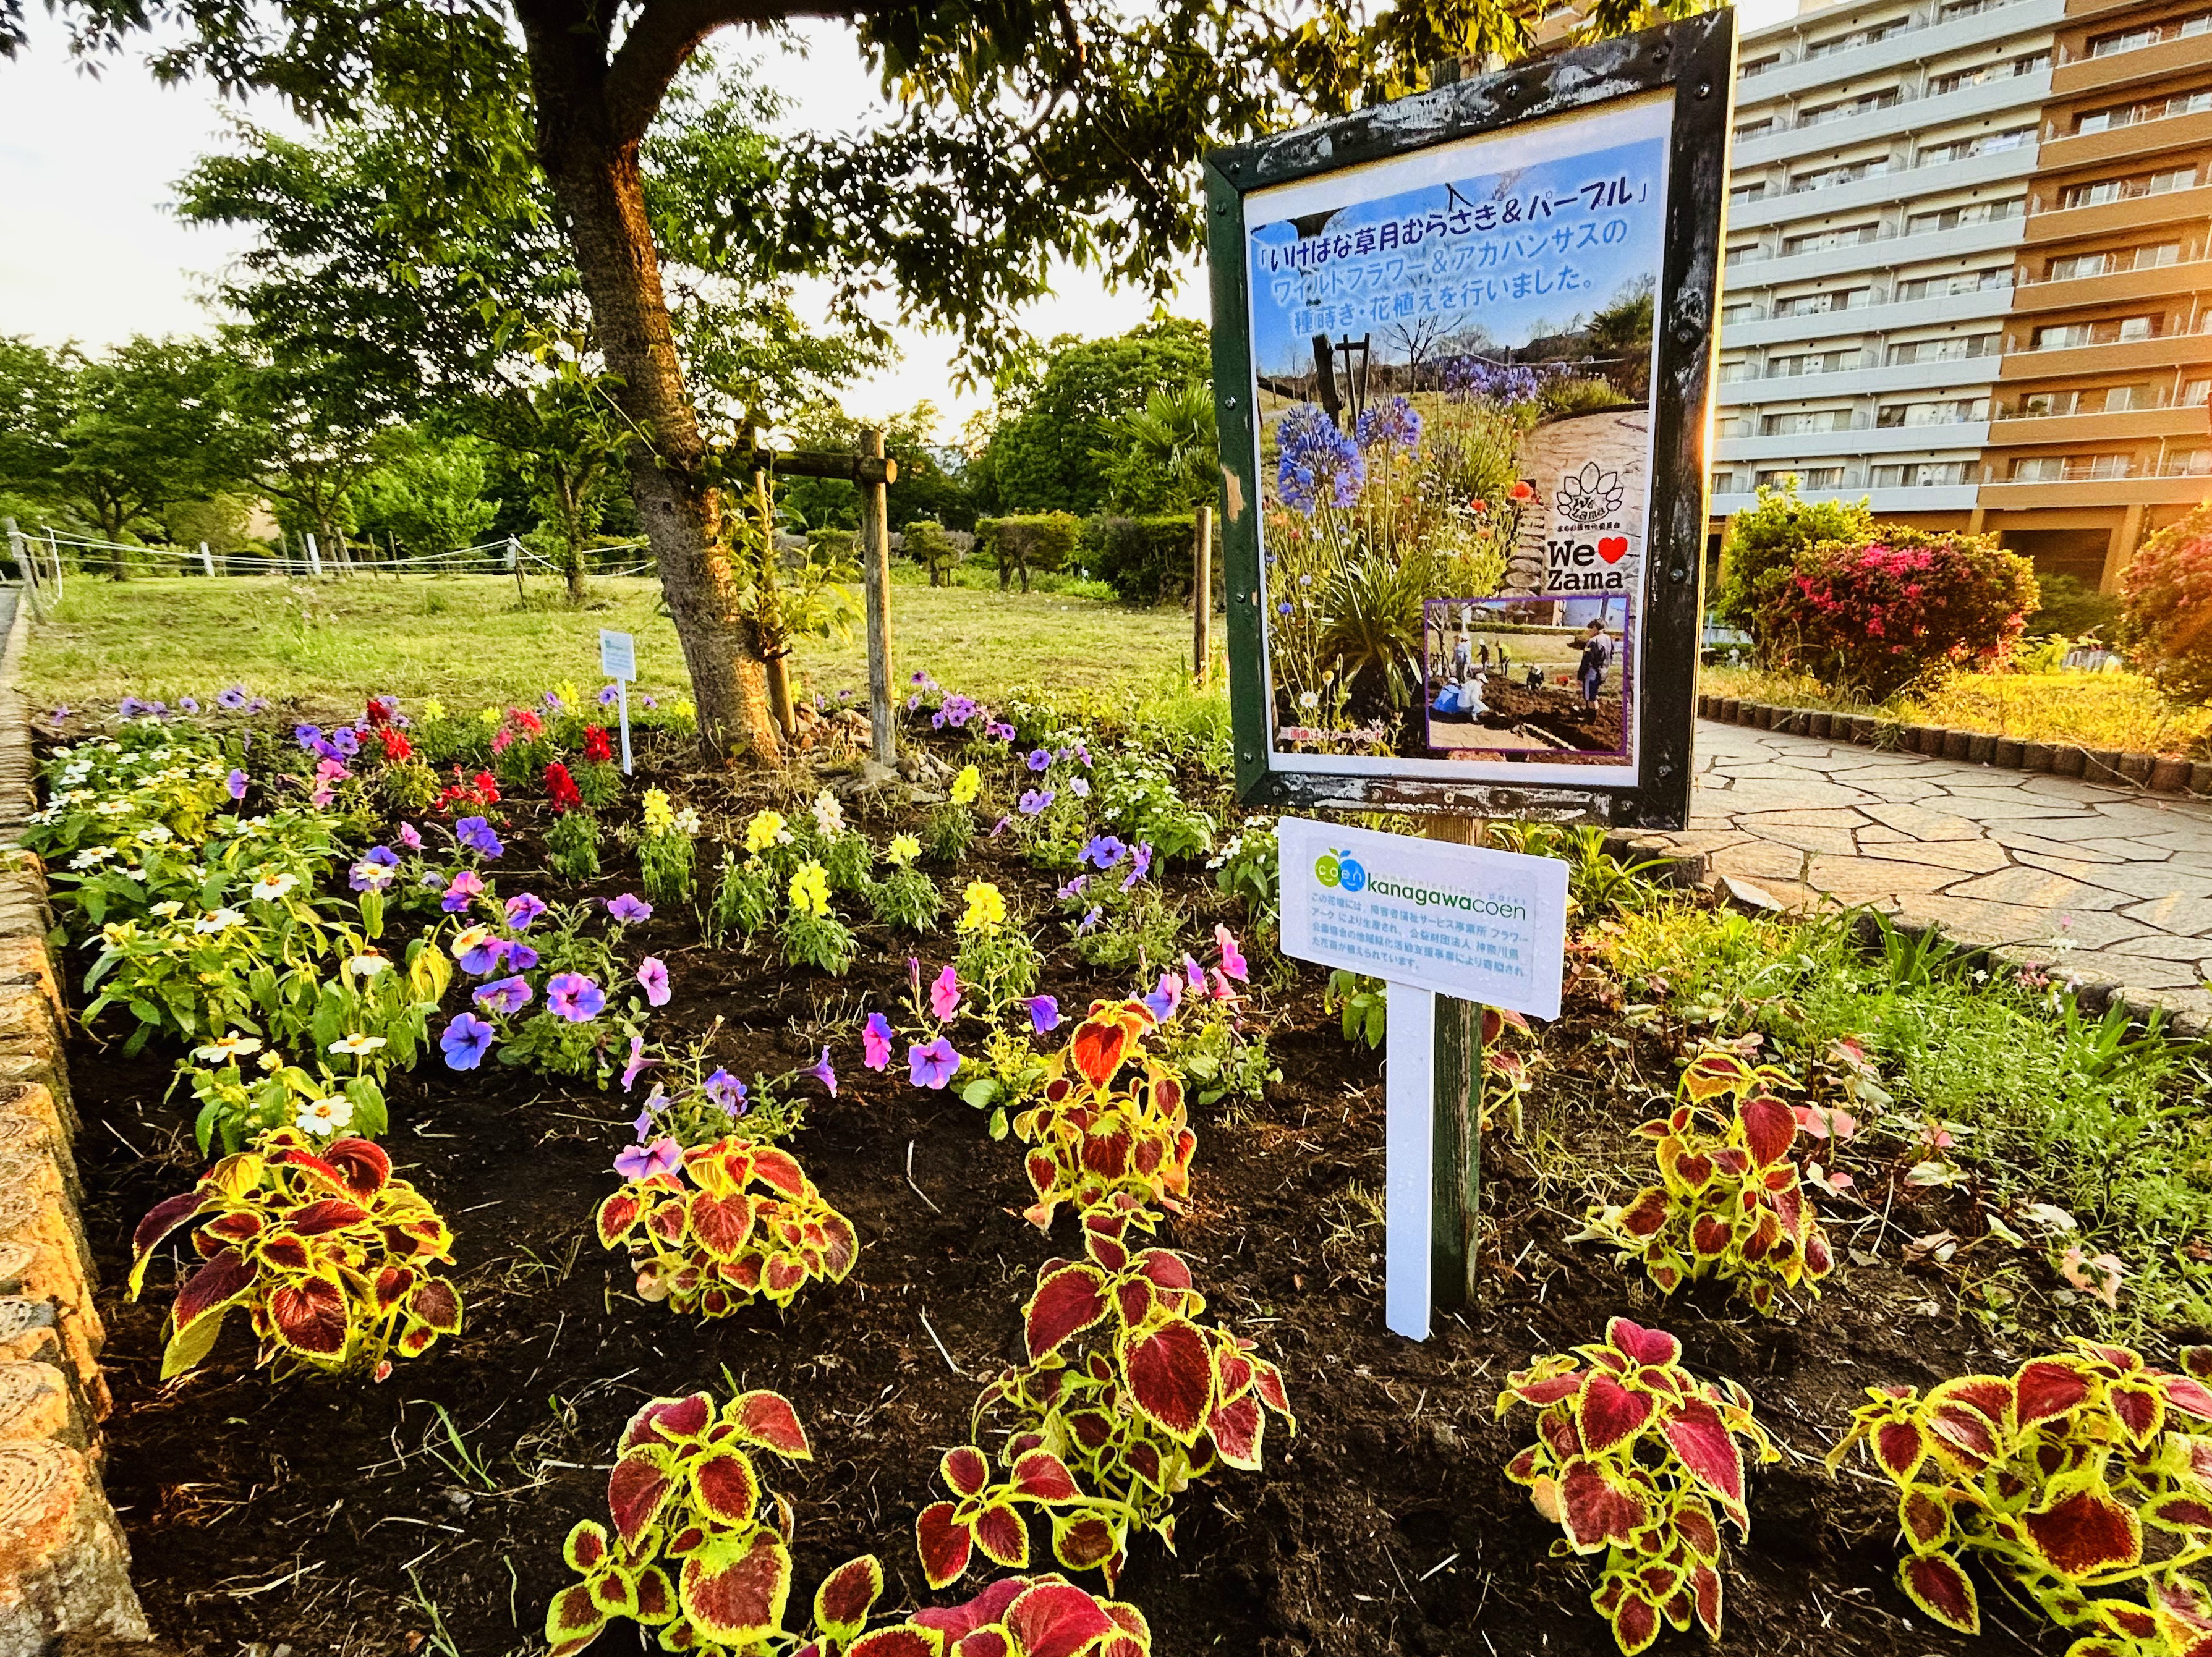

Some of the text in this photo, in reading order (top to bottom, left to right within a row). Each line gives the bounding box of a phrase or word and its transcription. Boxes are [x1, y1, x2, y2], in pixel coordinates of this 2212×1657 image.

[1547, 540, 1595, 567] We
[1547, 570, 1623, 591] Zama
[1368, 872, 1526, 921] kanagawacoen
[1311, 907, 1334, 919] アーク
